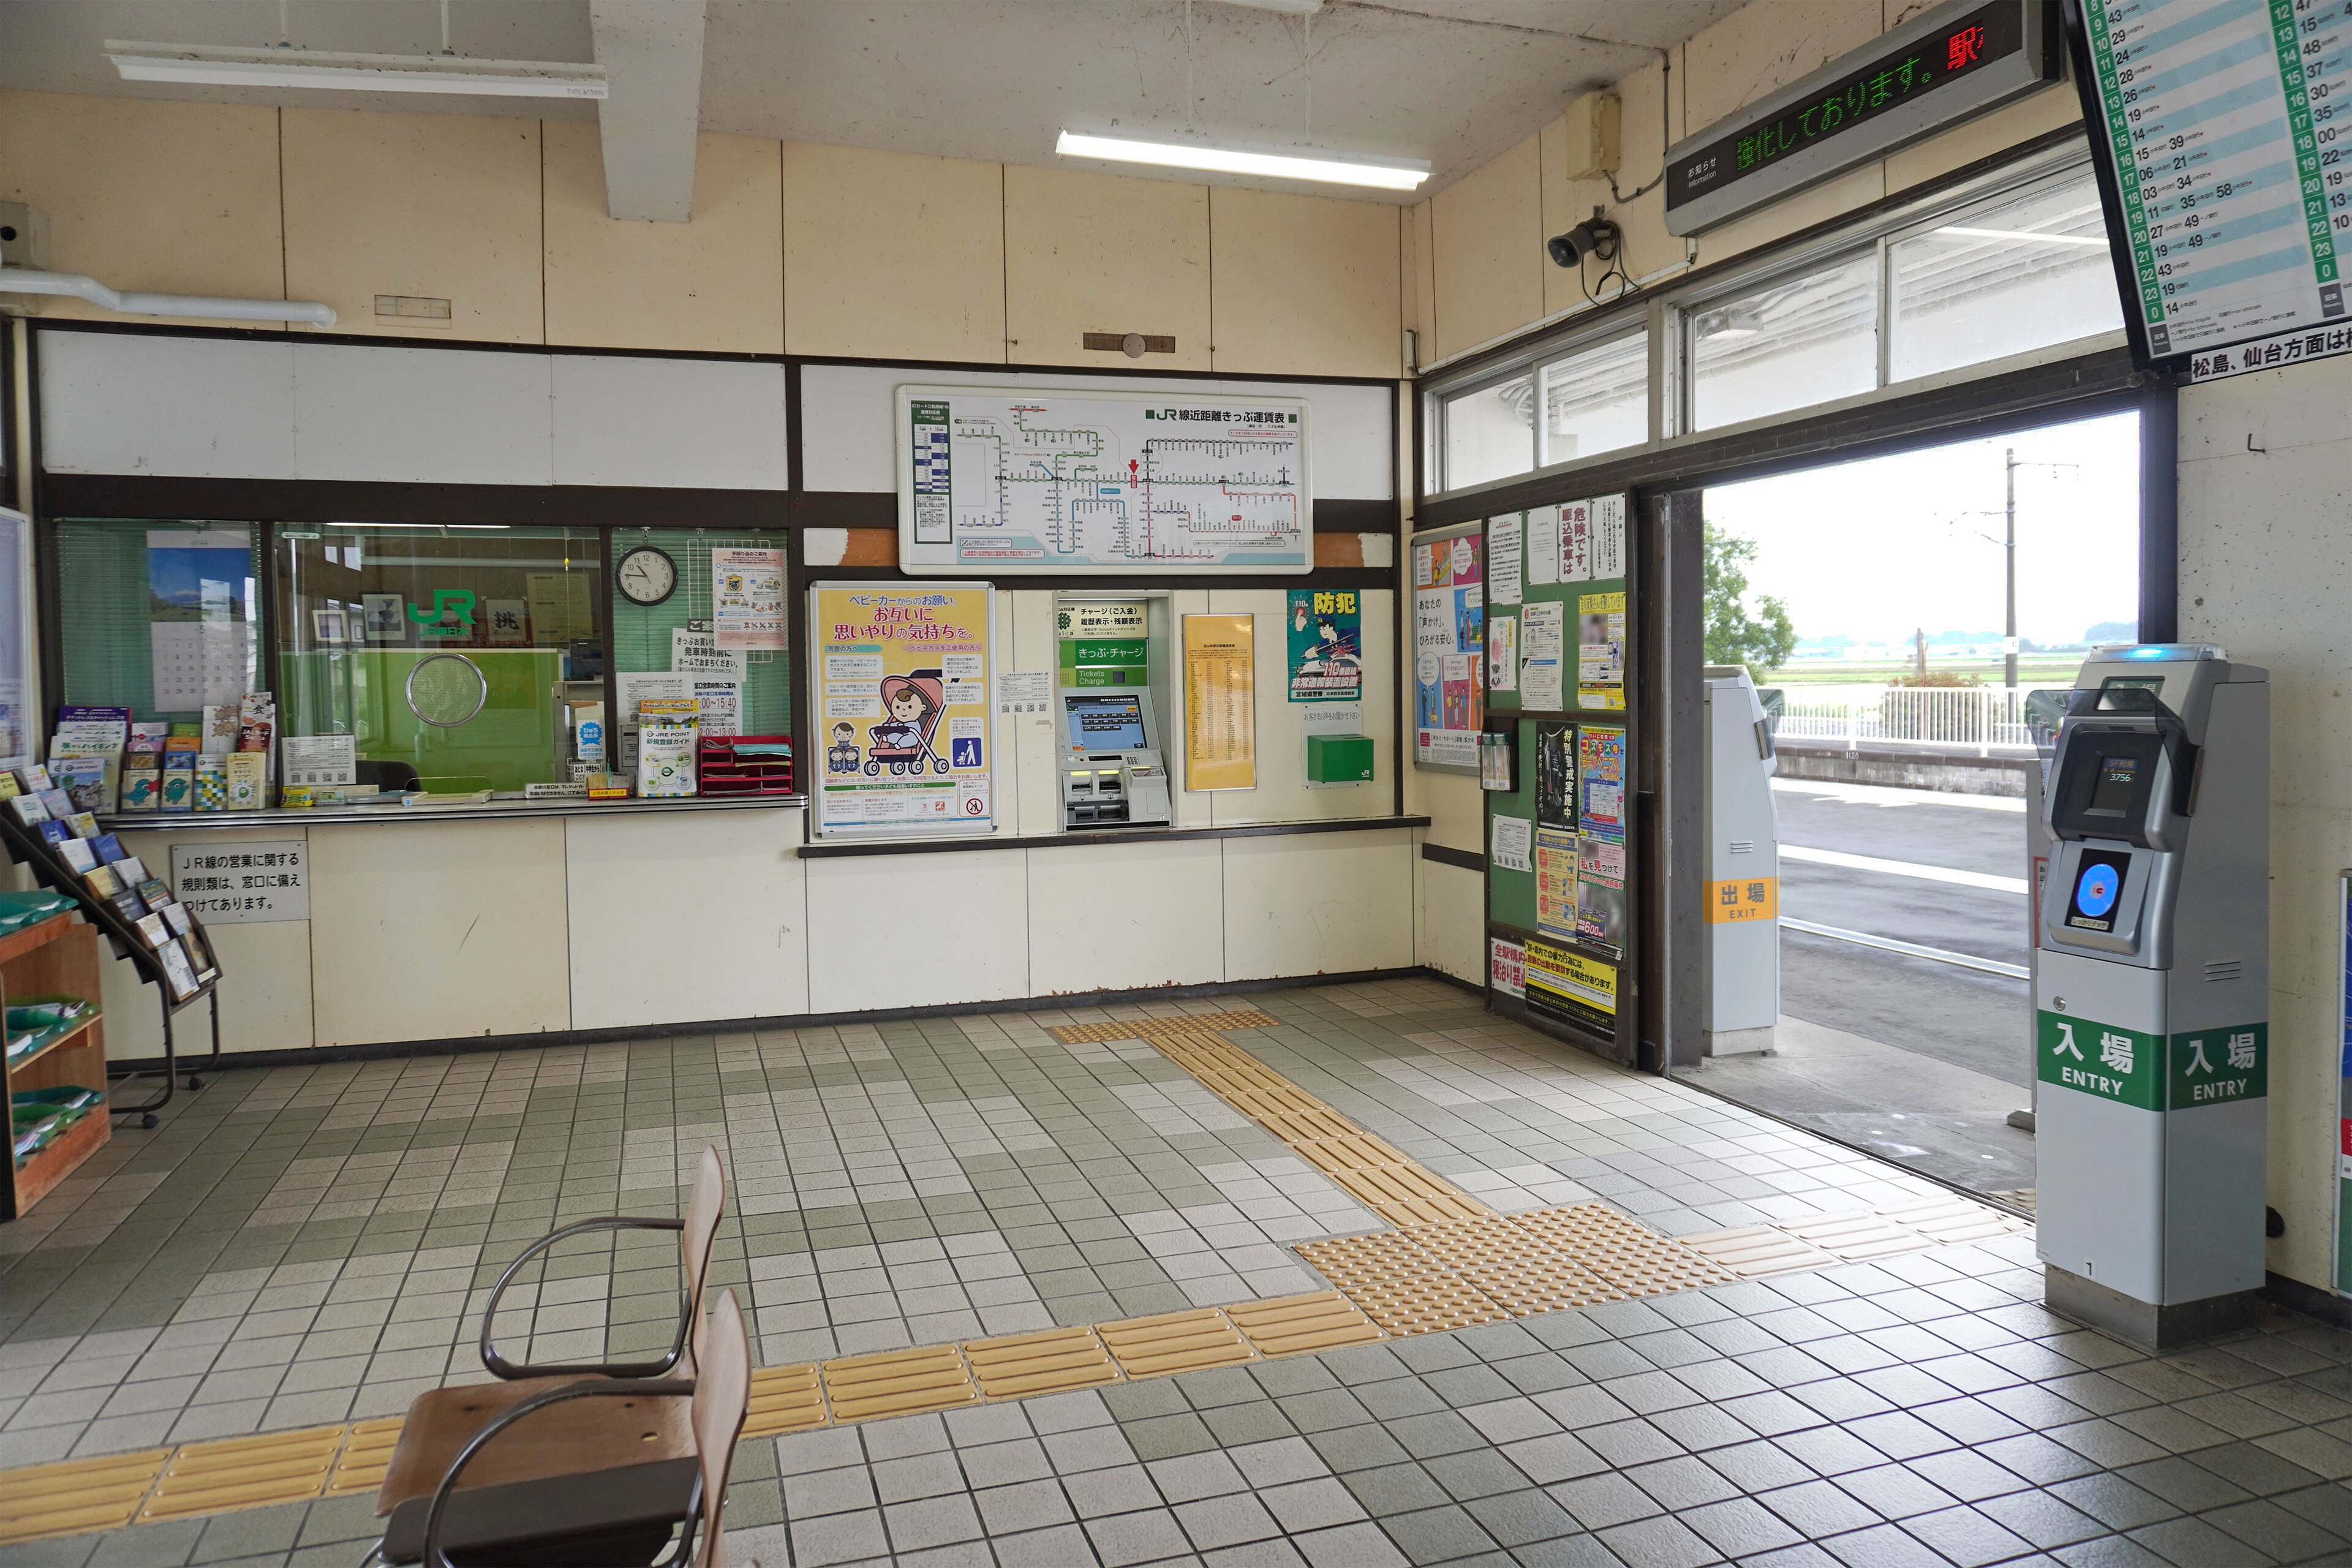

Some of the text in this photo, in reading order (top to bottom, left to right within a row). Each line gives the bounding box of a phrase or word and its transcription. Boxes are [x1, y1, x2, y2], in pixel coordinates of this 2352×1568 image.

[2095, 9, 2122, 31] 9 43
[2275, 4, 2290, 21] 12
[2096, 29, 2125, 51] 10 29
[2278, 17, 2316, 42] 13 15
[2100, 50, 2130, 70] 11 24
[2282, 40, 2321, 64] 14 48
[2103, 69, 2134, 89] 12 28
[2286, 61, 2323, 86] 15 37
[1735, 26, 1984, 171] 強化しております。 駅
[2108, 89, 2138, 109] 13 26
[2290, 84, 2328, 108] 16 30
[2112, 109, 2141, 129] 14 19
[2294, 105, 2332, 129] 17 35
[2116, 129, 2145, 148] 15 14
[2297, 127, 2336, 151] 18 00
[2120, 135, 2184, 167] 16 15 39
[2301, 149, 2340, 172] 19 22
[1687, 156, 1717, 178] お知らせ
[2124, 156, 2186, 186] 17 06 21
[1688, 170, 1716, 189] Information
[2128, 175, 2192, 205] 18 03 34
[2304, 172, 2343, 194] 20 19
[2131, 184, 2232, 224] 19 11 35 58
[2309, 193, 2346, 215] 21 13
[2134, 215, 2199, 244] 20 27 49
[2312, 214, 2350, 236] 22 10
[2138, 235, 2203, 262] 21 19 49
[2315, 242, 2332, 257] 23
[2141, 264, 2172, 281] 22 43
[2323, 264, 2331, 277] 0
[2145, 283, 2174, 301] 23 19
[2151, 302, 2179, 318] 0 14
[1562, 508, 1574, 575] 駆込乗車は
[1574, 507, 1587, 572] 危険です。
[407, 589, 477, 624] JR
[850, 595, 957, 606] ベビーカーからのお願い。
[1314, 592, 1356, 614] 防犯
[1419, 598, 1441, 610] あなたの
[874, 607, 934, 622] お互いに
[419, 627, 469, 636] JR東日本
[834, 624, 974, 640] 思いやりの気持ちを。
[1420, 633, 1455, 646] ひろがる安心。
[679, 658, 738, 668] ホームでおまちください。
[1079, 647, 1144, 658] きっぷ・チャージ
[1292, 677, 1359, 688] 非常通報装置設置
[253, 705, 265, 715] 食
[695, 698, 736, 708] :00~15:40
[1304, 712, 1360, 720] お客さまの声をお聞かせ下さい
[1564, 729, 1574, 819] 特別警戒実施中
[1582, 754, 1621, 772] ヨークベニマル
[2109, 760, 2135, 768] SF利用
[181, 873, 301, 891] 規則類は、窓口に備え
[184, 896, 273, 912] つけてあります。
[1721, 883, 1765, 906] 出場
[1729, 908, 1756, 919] EXIT
[1495, 944, 1525, 965] 全駅構内
[1528, 944, 1585, 970] 駅・車内での暴力行為には、
[1493, 959, 1526, 988] 寝泊り禁止
[1528, 954, 1614, 992] 警察の出動を要請する場合があります。
[2052, 1022, 2135, 1074] 入場
[2185, 1033, 2256, 1077] 入場
[2062, 1066, 2123, 1096] ENTRY
[2193, 1079, 2248, 1101] ENTRY
[2086, 1262, 2092, 1276] 1
